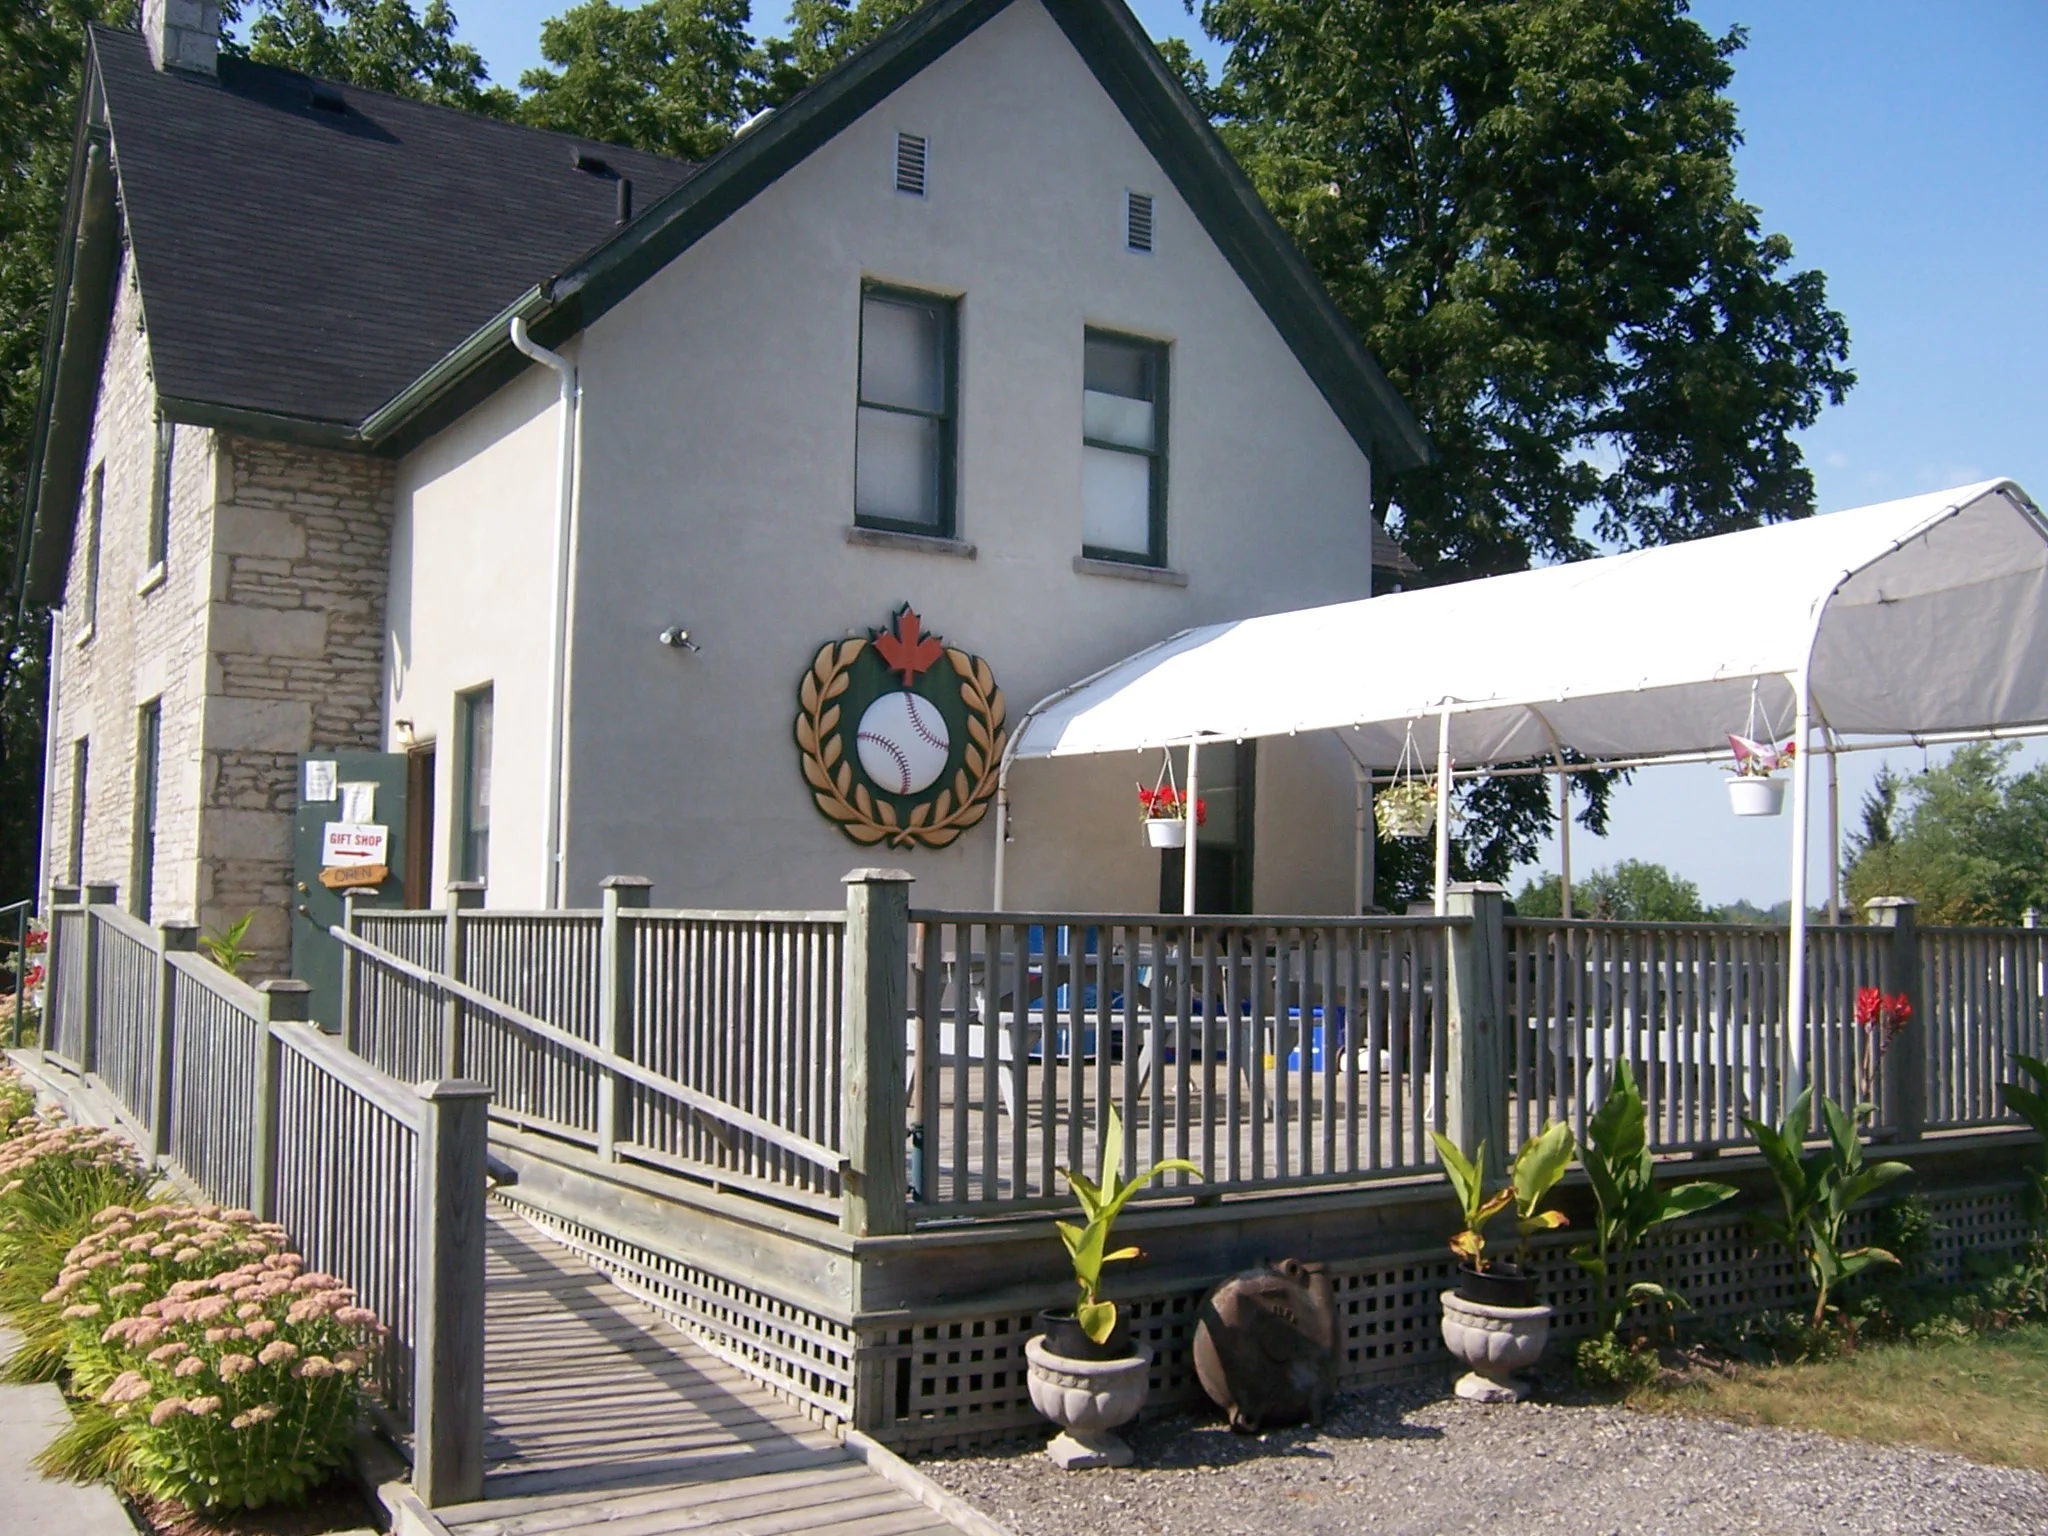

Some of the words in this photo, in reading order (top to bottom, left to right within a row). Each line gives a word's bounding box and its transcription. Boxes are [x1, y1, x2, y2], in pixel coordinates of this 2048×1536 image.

[330, 833, 352, 845] GIFT
[354, 834, 383, 847] SHOP
[334, 867, 372, 882] OPEN
